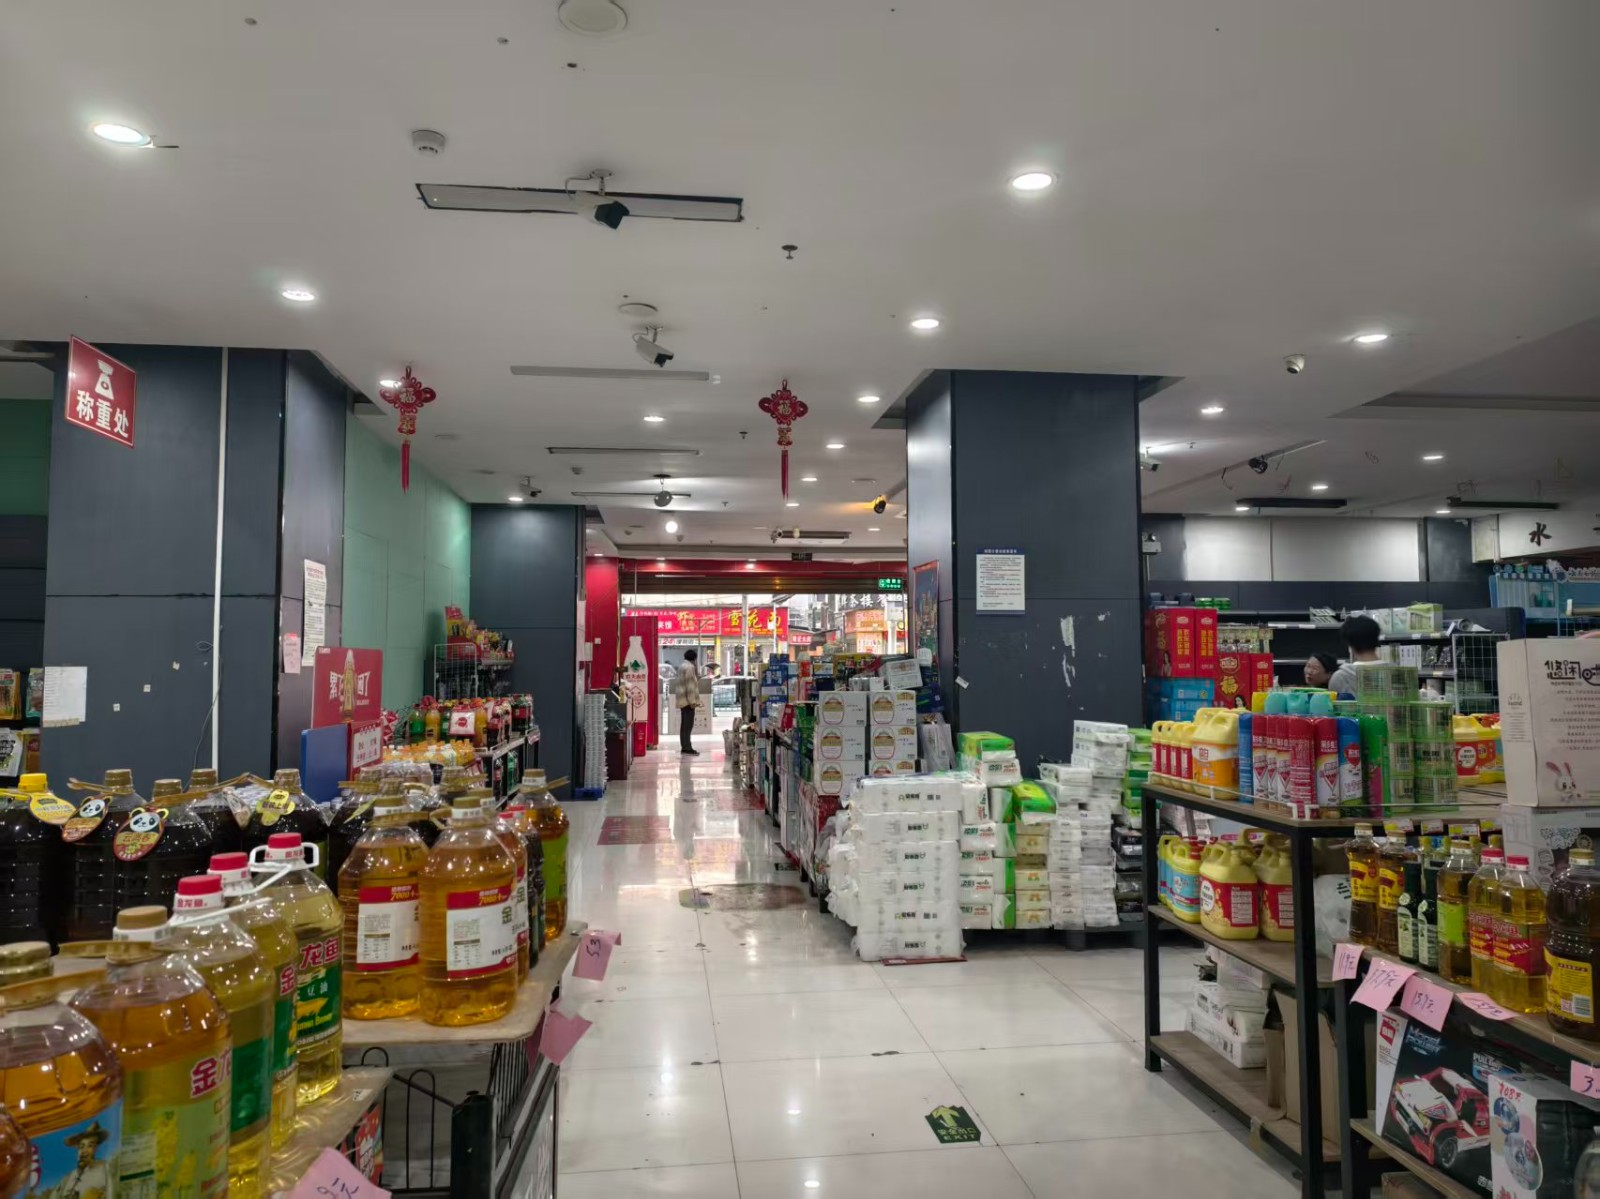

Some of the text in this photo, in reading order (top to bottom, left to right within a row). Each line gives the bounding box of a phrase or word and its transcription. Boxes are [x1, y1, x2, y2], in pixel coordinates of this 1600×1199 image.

[76, 389, 130, 438] 称重处
[1528, 521, 1553, 547] 水
[301, 936, 340, 969] 龙鱼
